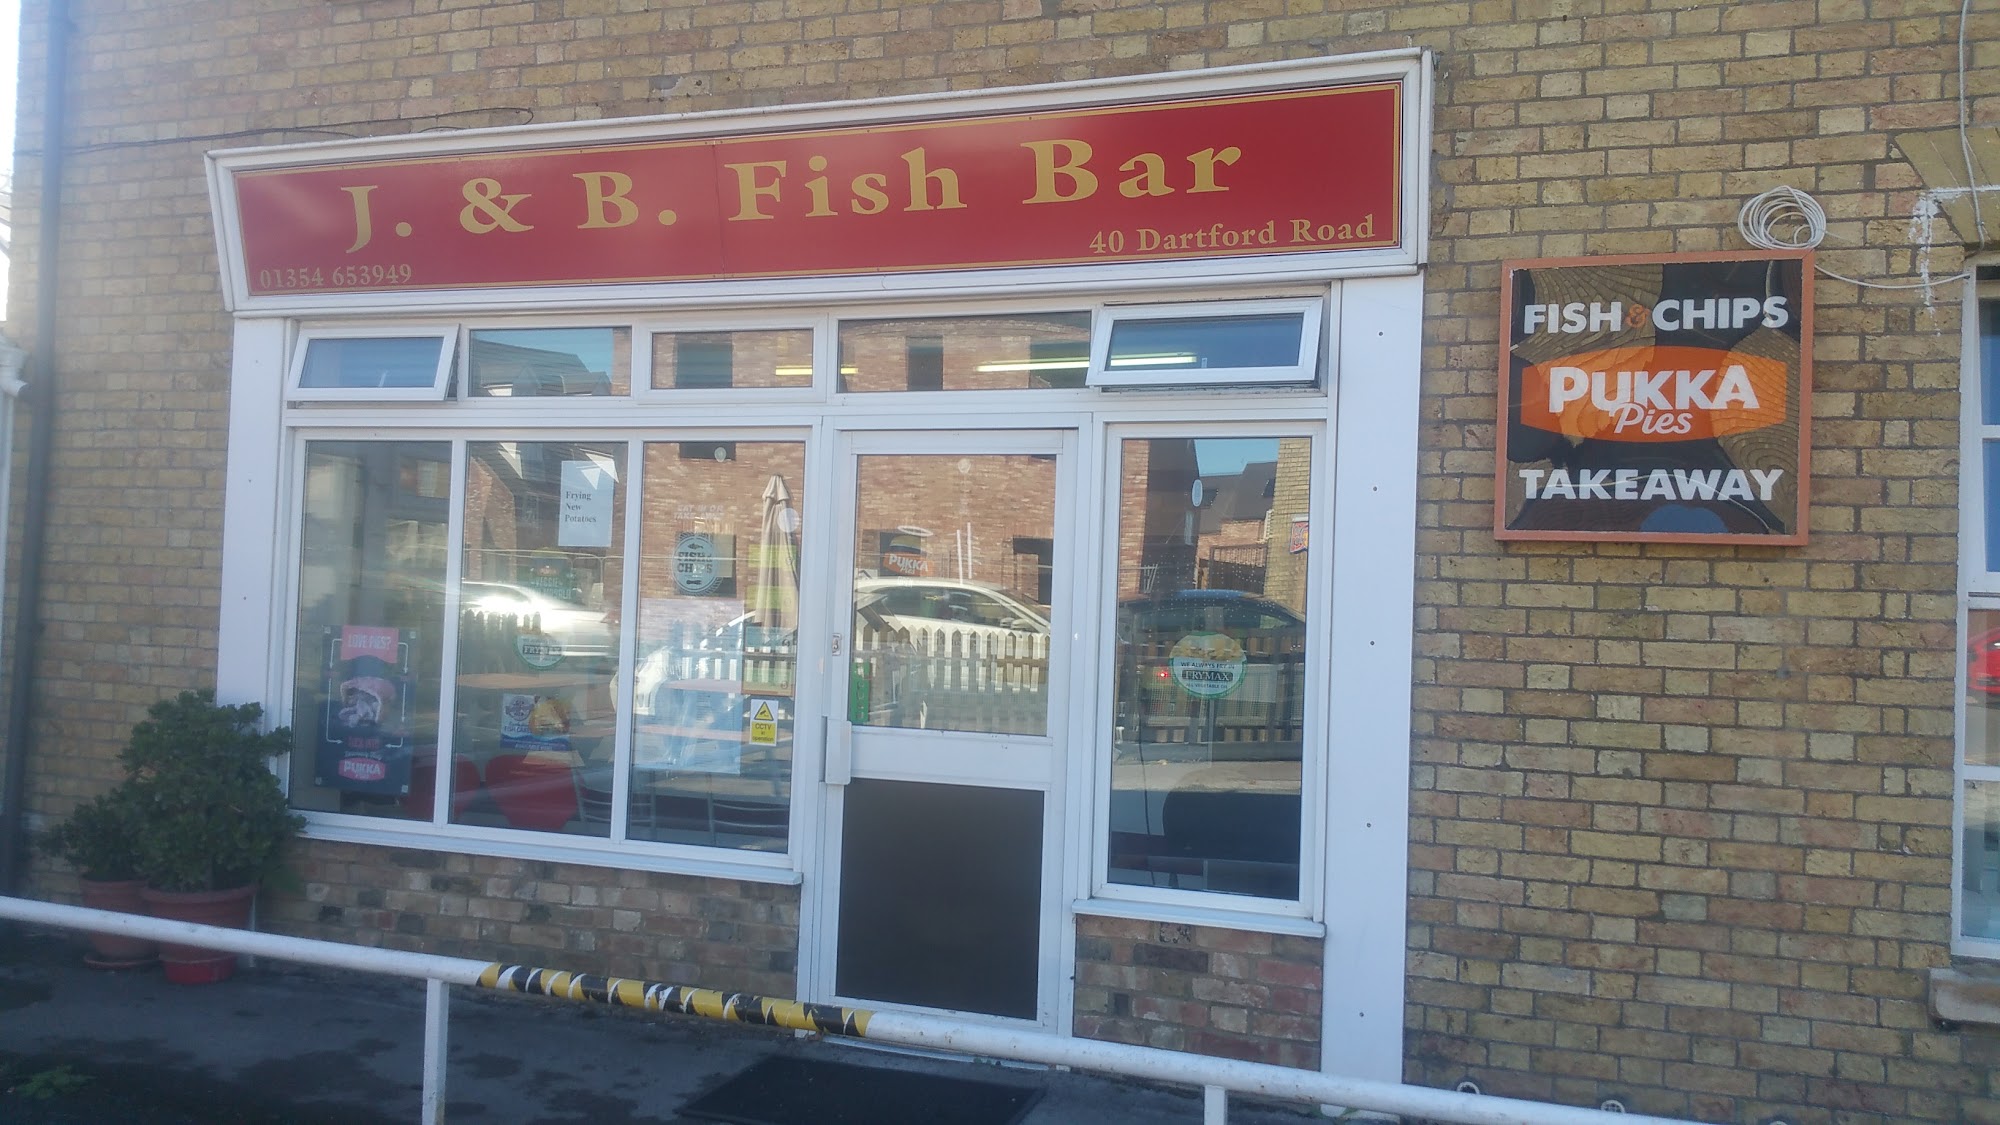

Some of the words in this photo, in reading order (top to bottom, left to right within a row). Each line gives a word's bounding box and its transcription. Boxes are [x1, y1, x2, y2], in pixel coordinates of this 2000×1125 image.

[340, 184, 413, 254] J.
[459, 177, 535, 235] &
[572, 171, 678, 229] B.
[724, 146, 968, 222] Fish
[1020, 137, 1243, 204] Bar
[1088, 230, 1125, 254] 40
[1137, 221, 1277, 252] Dartford
[1290, 214, 1376, 242] Road
[259, 267, 324, 289] 01354
[332, 263, 412, 286] 653949
[1523, 301, 1622, 334] FISH
[1625, 303, 1650, 329] &
[1652, 296, 1789, 331] CHIPS
[1548, 365, 1760, 415] PUKKA
[1613, 401, 1693, 435] Pies
[565, 491, 592, 501] Frying
[1519, 469, 1784, 501] TAKEAWAY
[564, 514, 597, 523] Potatoes
[677, 551, 706, 562] FISH
[888, 553, 928, 572] PUKKA
[1185, 671, 1230, 681] FRYMAX
[754, 722, 772, 730] CCTV
[344, 760, 380, 774] PUKKA
